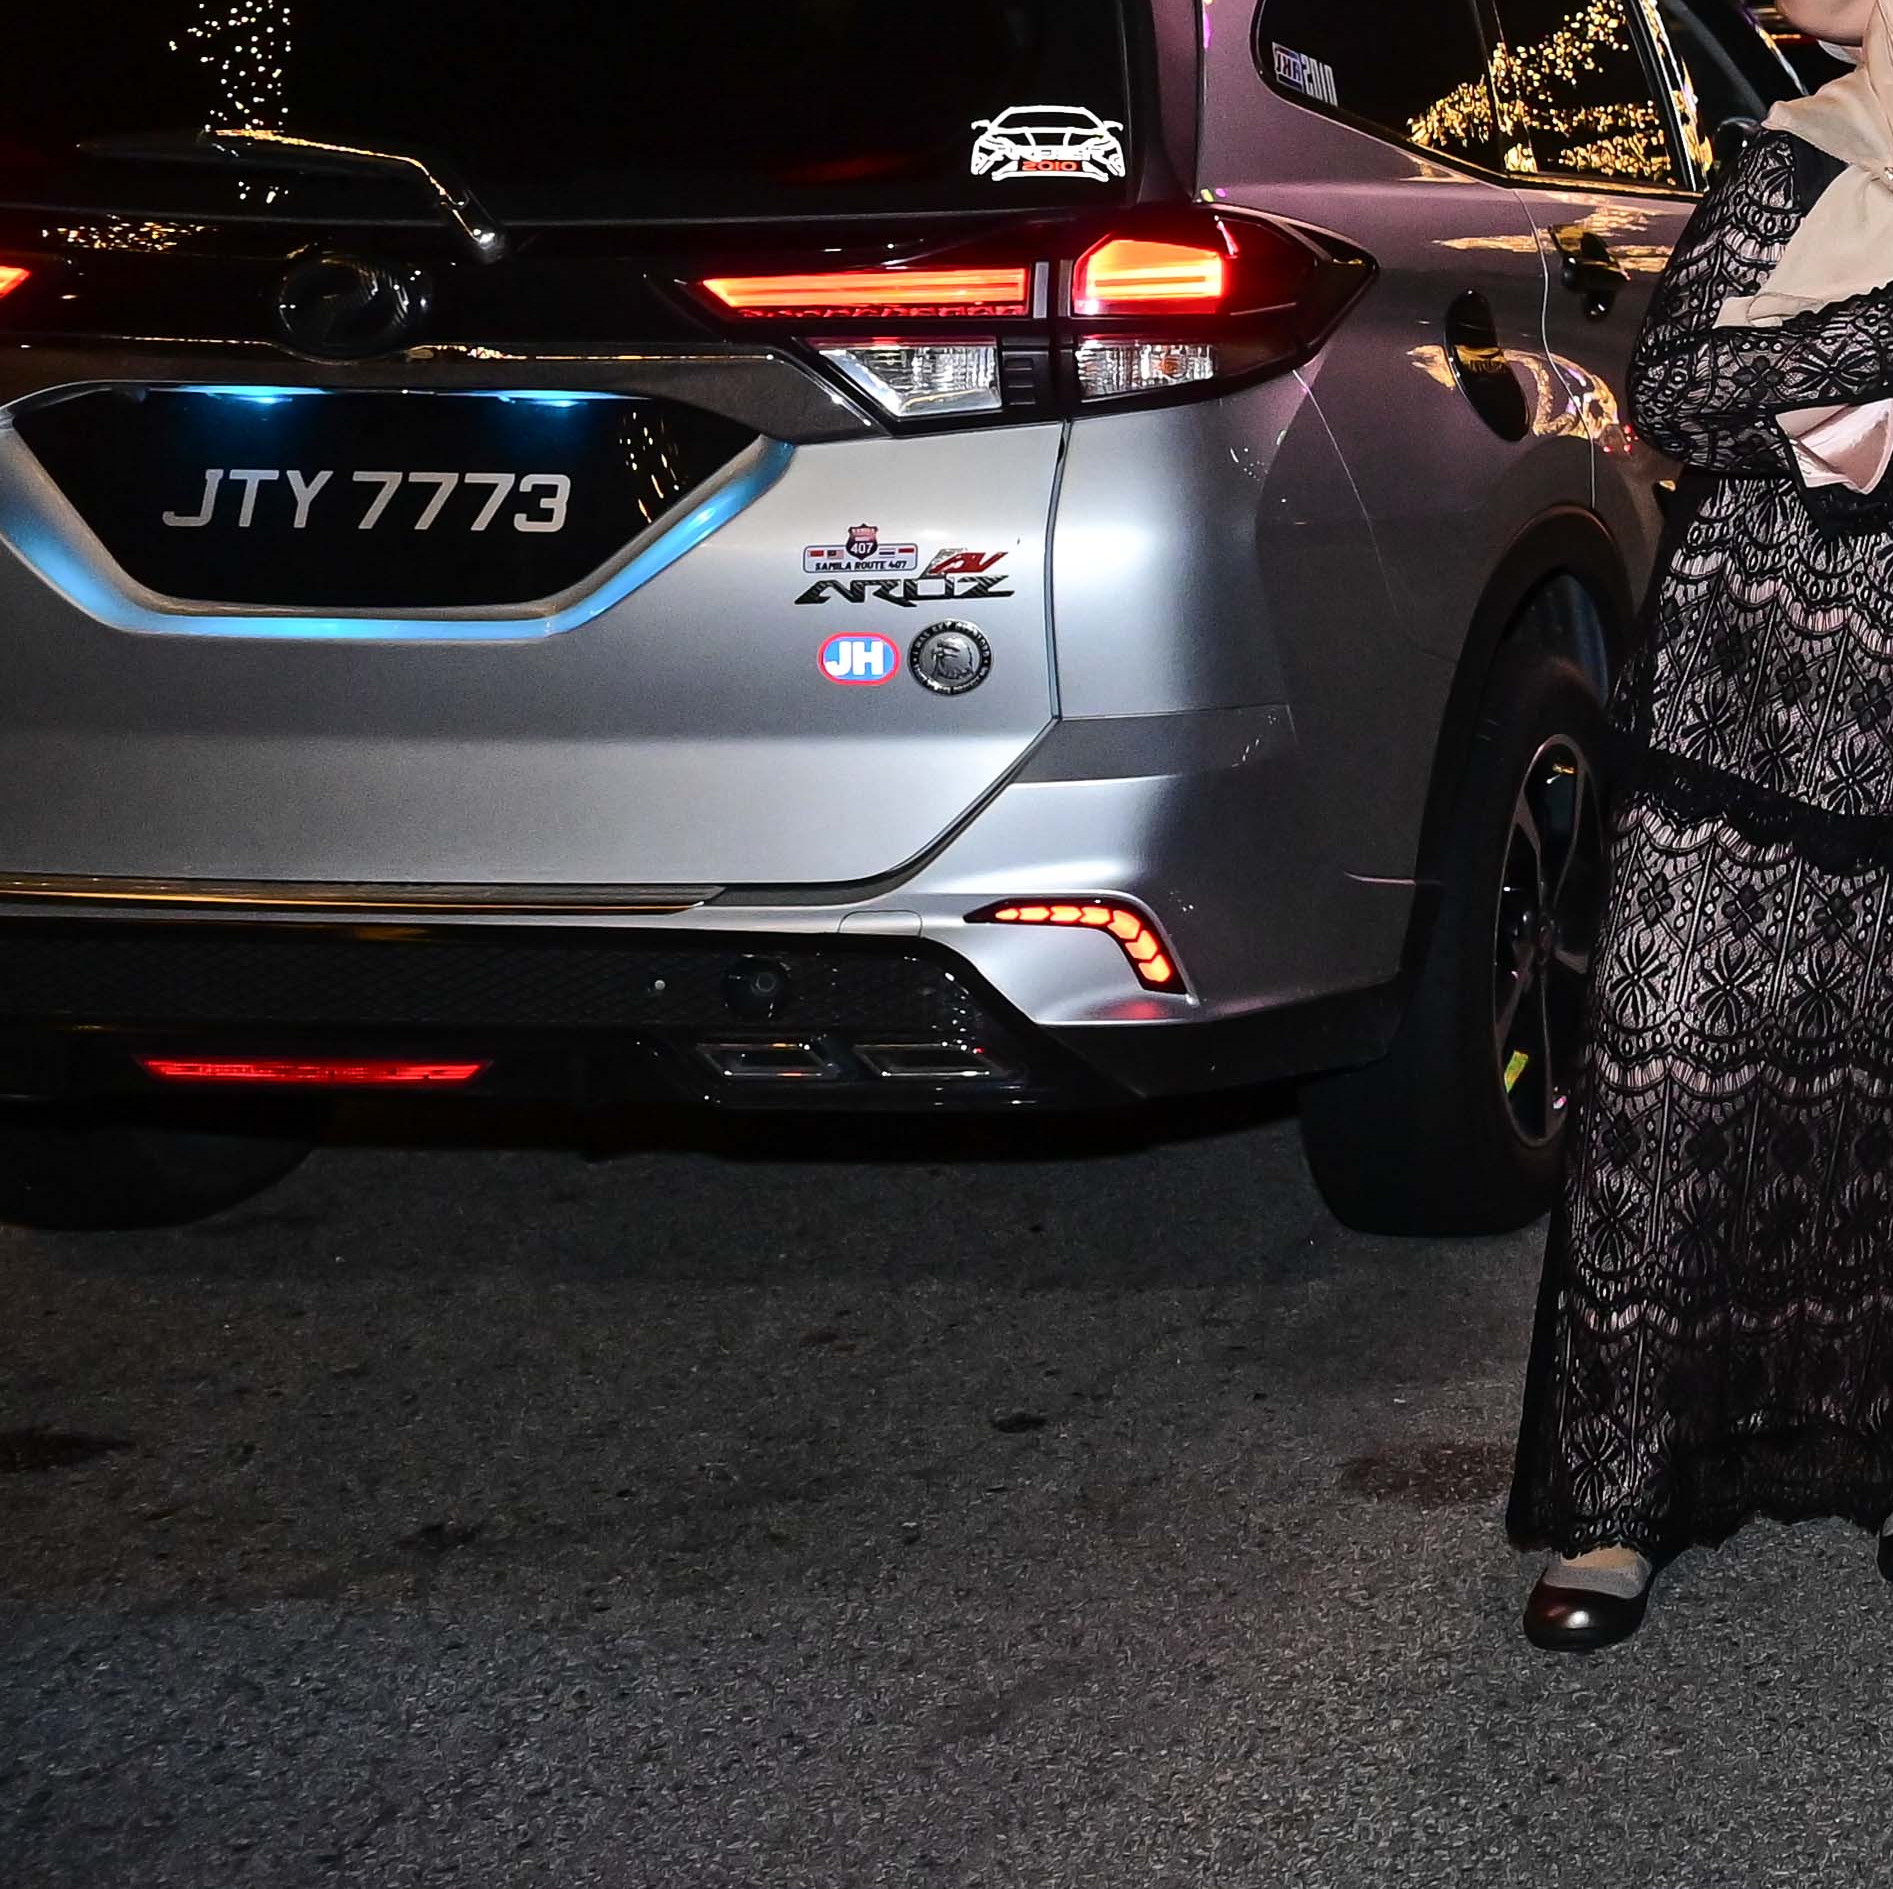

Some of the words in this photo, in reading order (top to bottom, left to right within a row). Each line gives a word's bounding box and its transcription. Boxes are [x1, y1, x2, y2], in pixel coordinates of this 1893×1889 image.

[1300, 53, 1338, 107] 2010
[1022, 160, 1078, 171] 2010
[162, 468, 333, 528] JTY
[352, 470, 571, 532] 7773
[850, 542, 874, 554] 407
[815, 561, 851, 571] SAMILA
[854, 560, 887, 570] ROUTE
[888, 560, 908, 569] 407
[794, 575, 1015, 608] ARUZ
[825, 641, 884, 677] JH
